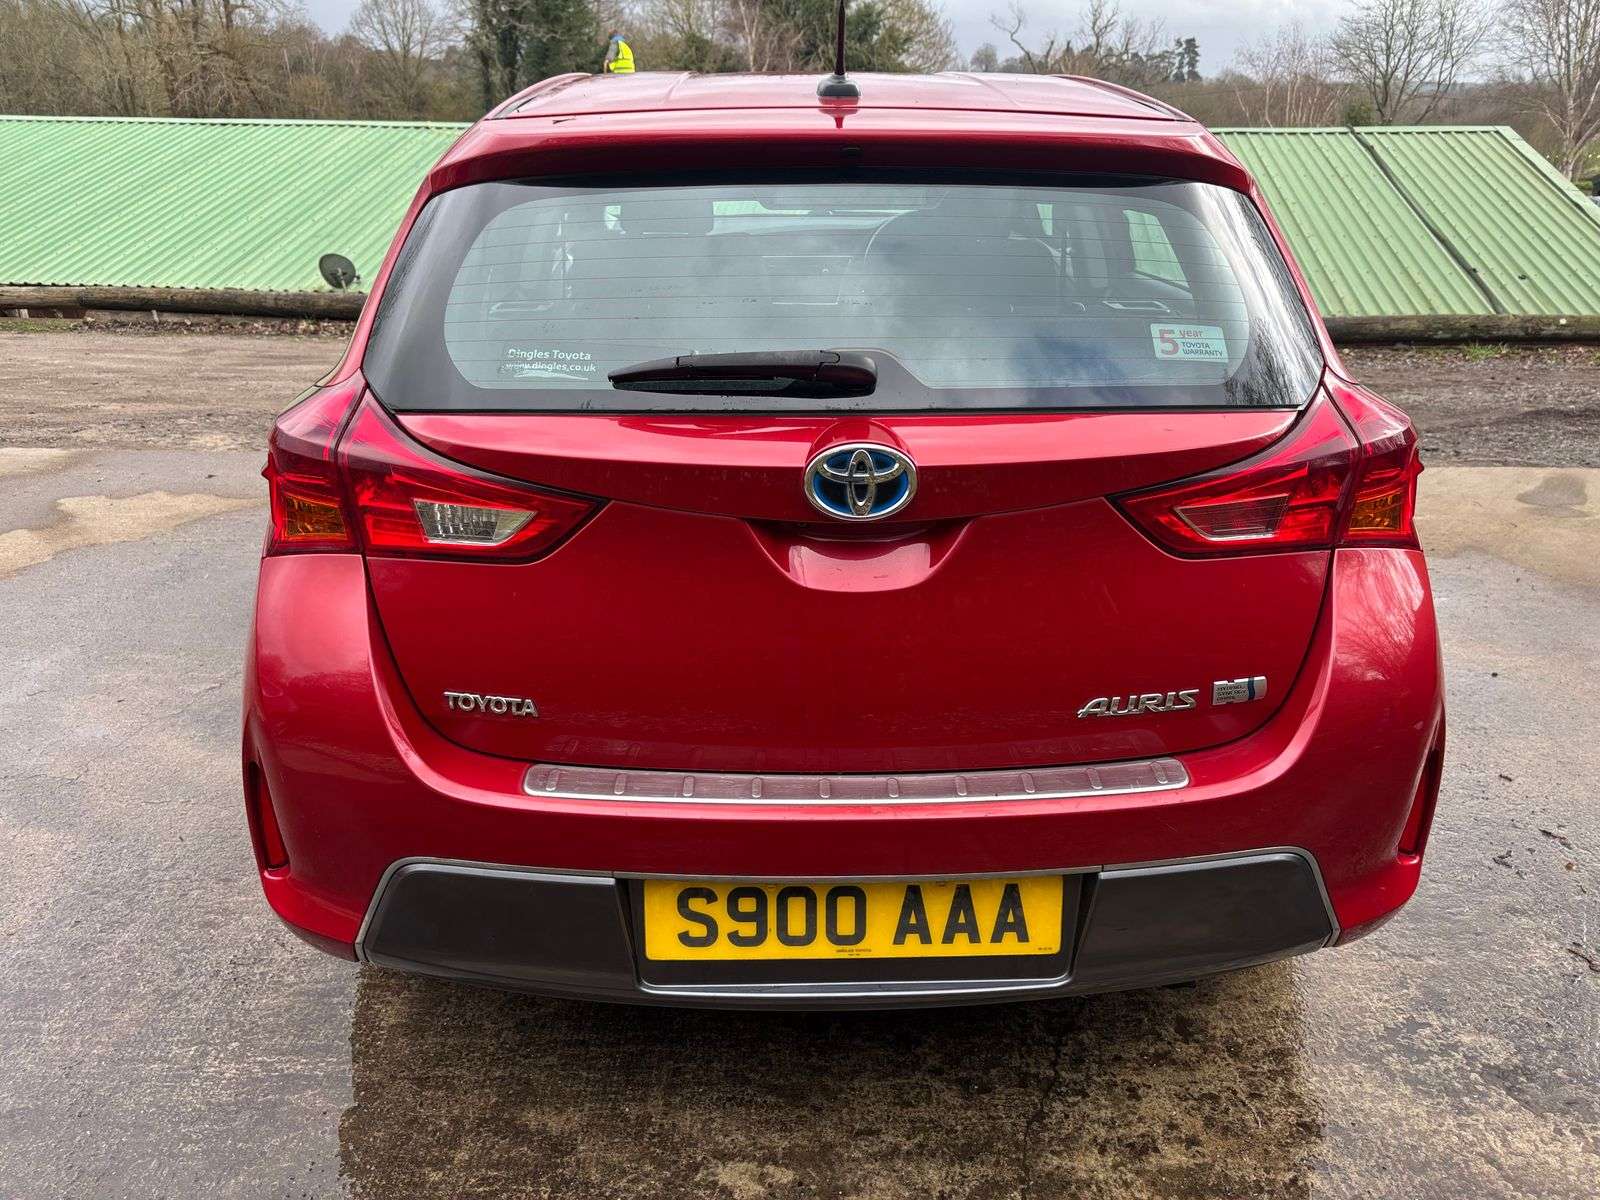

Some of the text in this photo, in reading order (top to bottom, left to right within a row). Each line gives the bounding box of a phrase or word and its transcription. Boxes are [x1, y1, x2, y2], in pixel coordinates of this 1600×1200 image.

[507, 348, 592, 361] Dingles Toyota
[1158, 328, 1204, 356] 5 year
[1181, 341, 1211, 350] TOYOTA
[1182, 349, 1223, 357] WARRANTY
[443, 691, 539, 718] TOYOTA
[1077, 688, 1200, 719] AURIS
[676, 883, 1030, 948] S900 AAA
